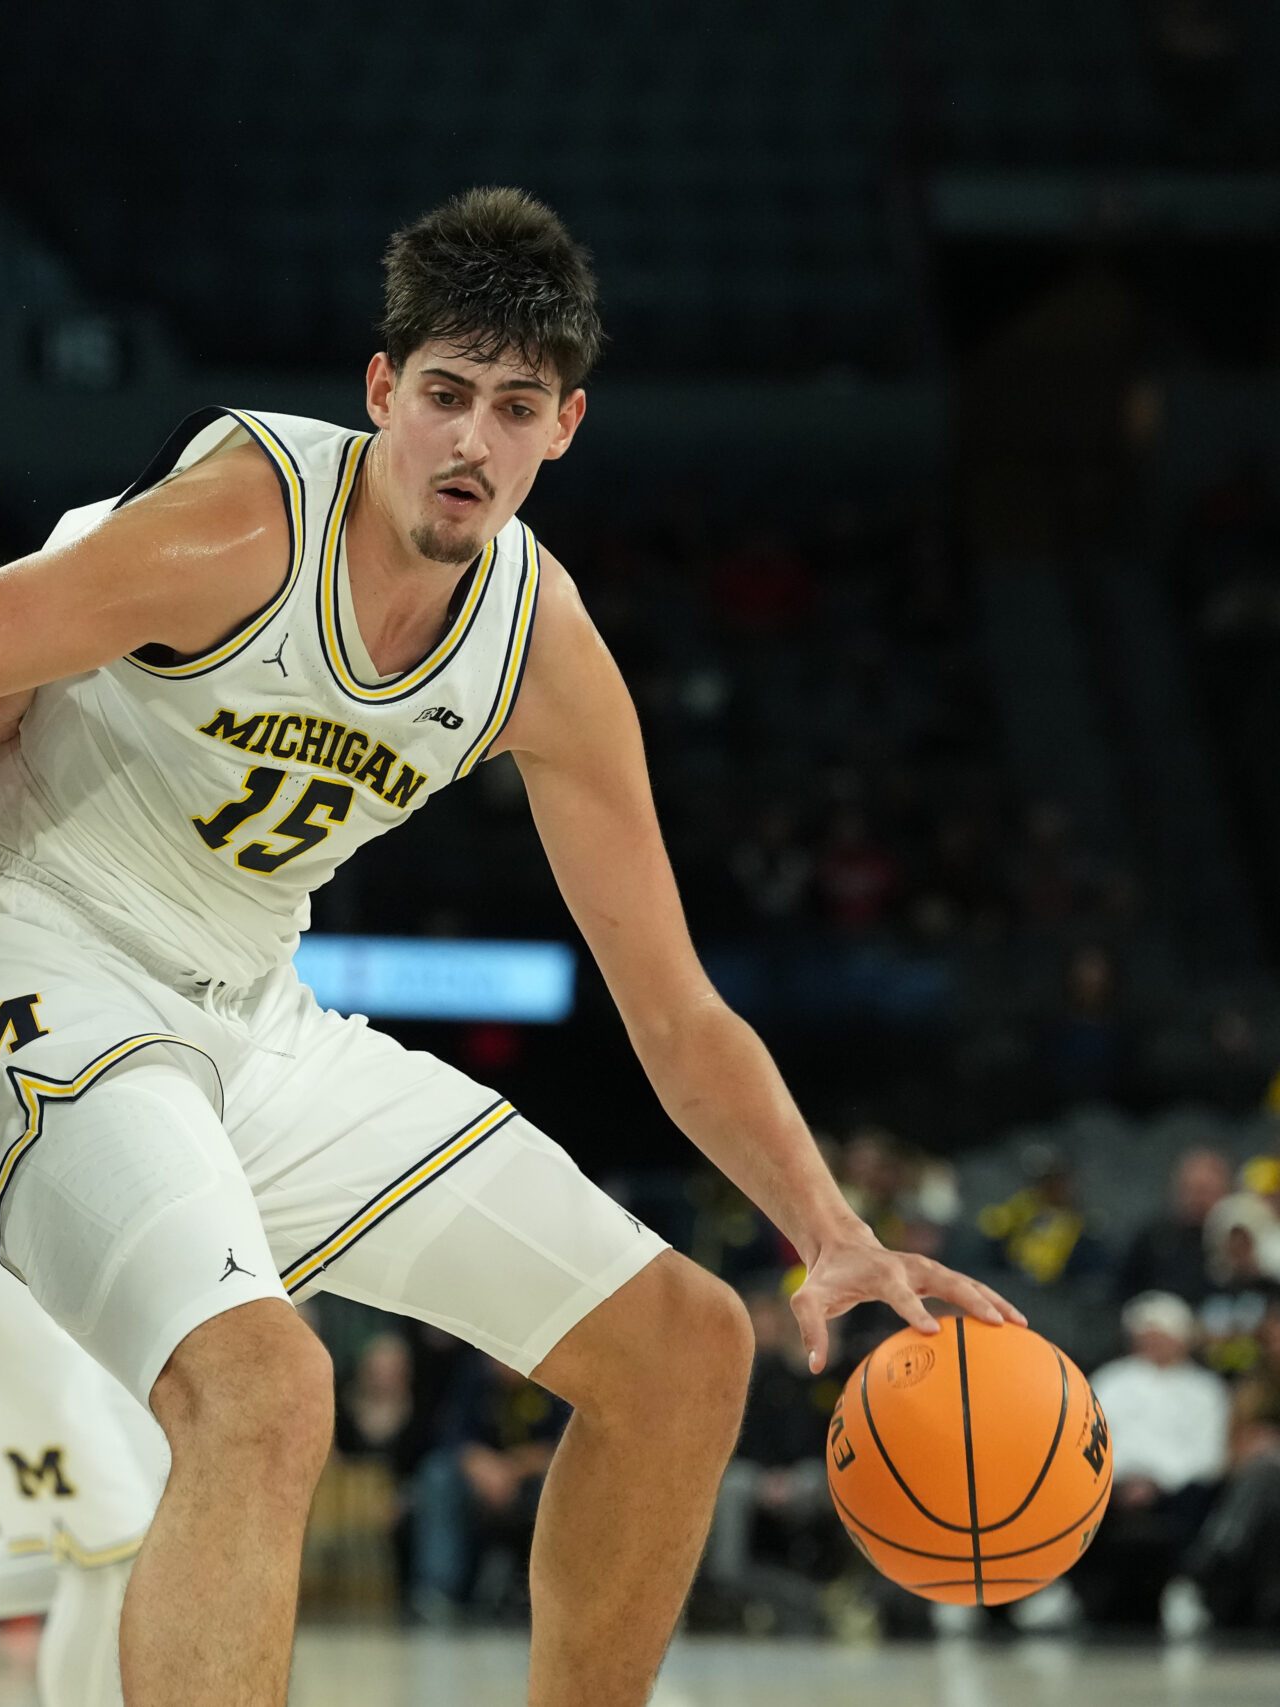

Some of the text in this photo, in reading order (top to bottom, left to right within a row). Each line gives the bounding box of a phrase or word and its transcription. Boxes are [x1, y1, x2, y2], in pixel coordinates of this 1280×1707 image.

[196, 707, 429, 810] MICHIGAN
[191, 765, 355, 878] 15
[3, 1443, 78, 1500] M
